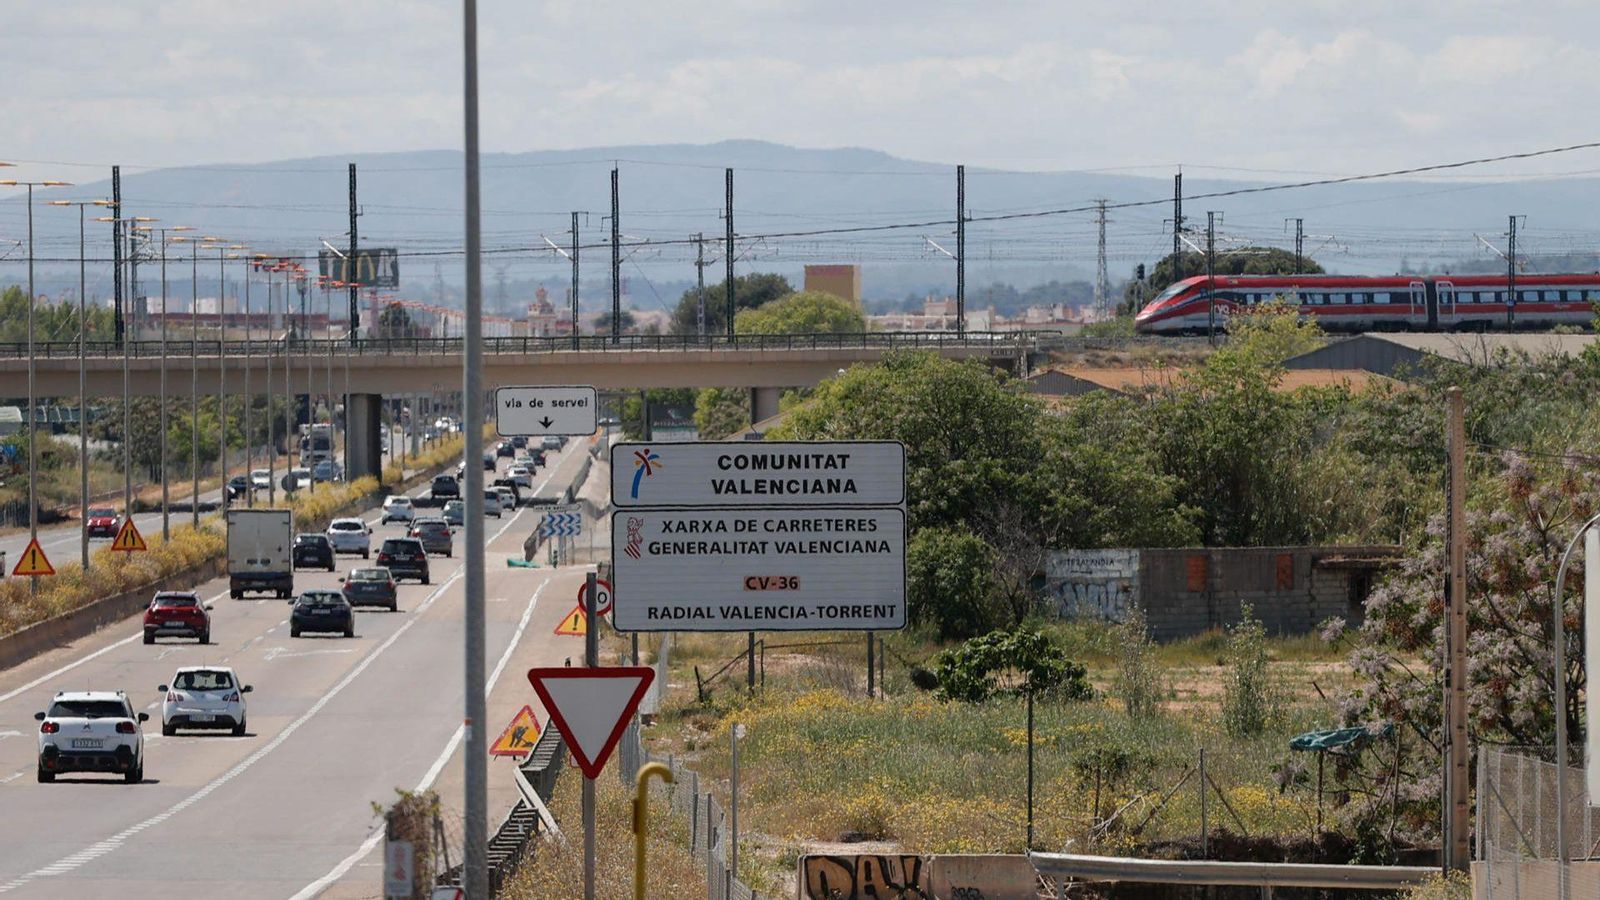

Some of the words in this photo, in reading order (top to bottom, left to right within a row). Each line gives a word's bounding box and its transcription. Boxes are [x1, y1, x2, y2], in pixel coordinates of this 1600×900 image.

[505, 397, 522, 408] via
[529, 397, 544, 408] de
[551, 397, 588, 408] servei
[717, 454, 851, 471] COMUNITAT
[710, 478, 858, 495] VALENCIANA
[661, 519, 728, 533] XARXA
[734, 519, 758, 533] DE
[763, 518, 877, 533] CARRETERES
[648, 541, 769, 555] GENERALITAT
[775, 540, 891, 554] VALENCIANA
[745, 576, 799, 590] CV-36
[647, 606, 716, 620] RADIAL
[719, 605, 897, 620] VALENCIA-TORRENT
